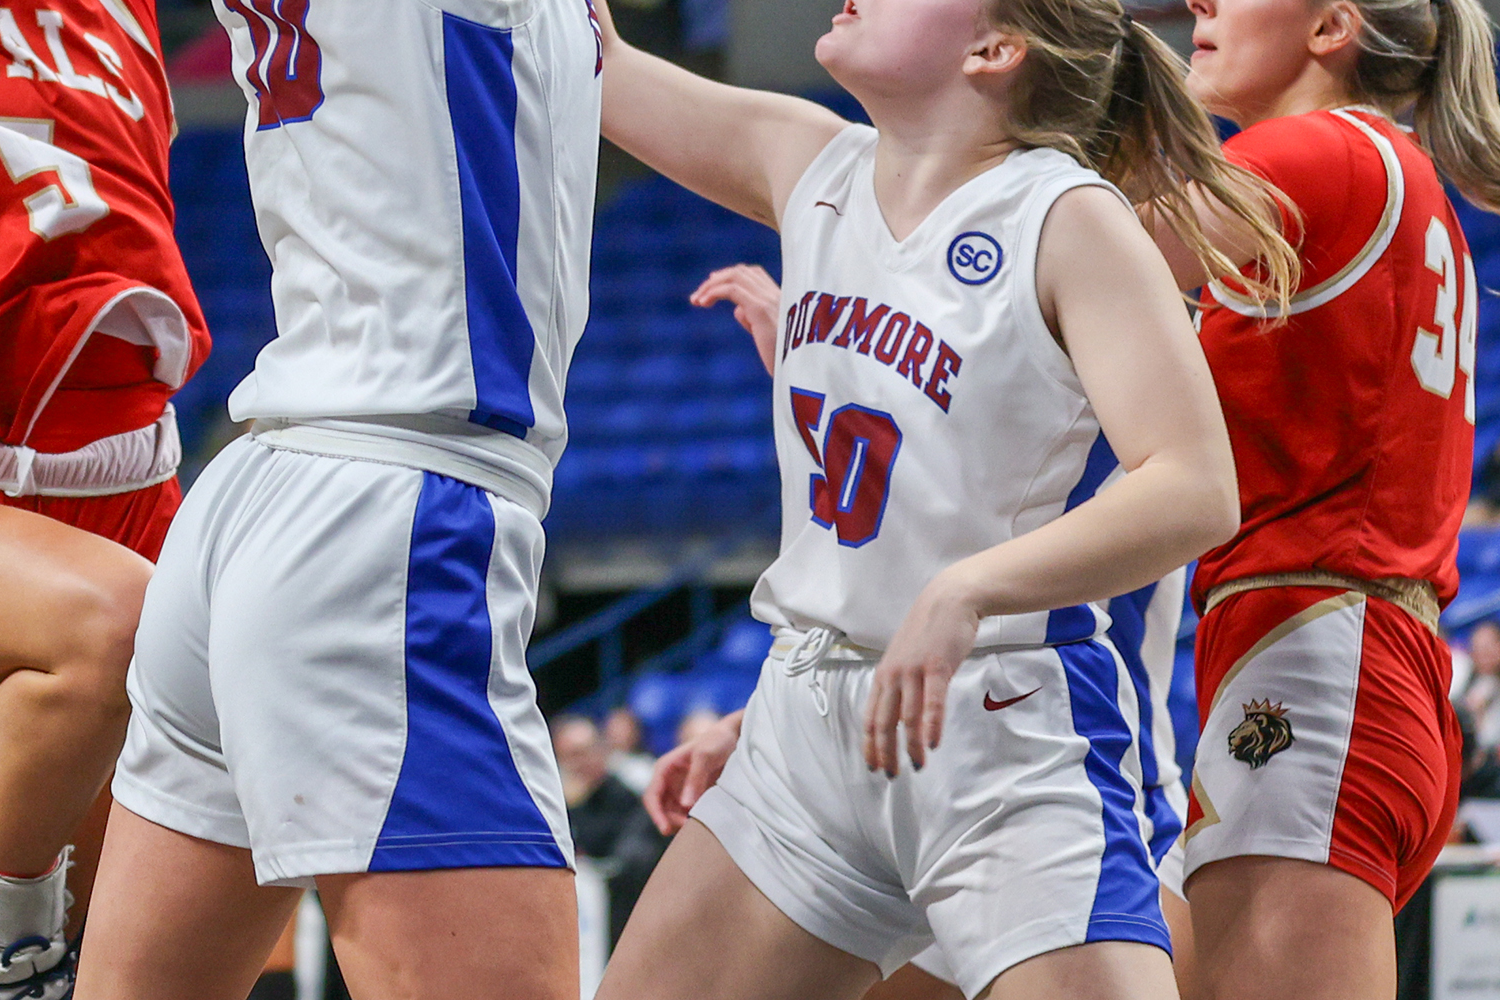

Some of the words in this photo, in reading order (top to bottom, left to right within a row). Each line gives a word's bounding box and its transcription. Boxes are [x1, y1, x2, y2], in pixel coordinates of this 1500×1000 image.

[955, 243, 994, 274] SC
[1410, 215, 1479, 427] 34
[789, 385, 903, 549] 50
